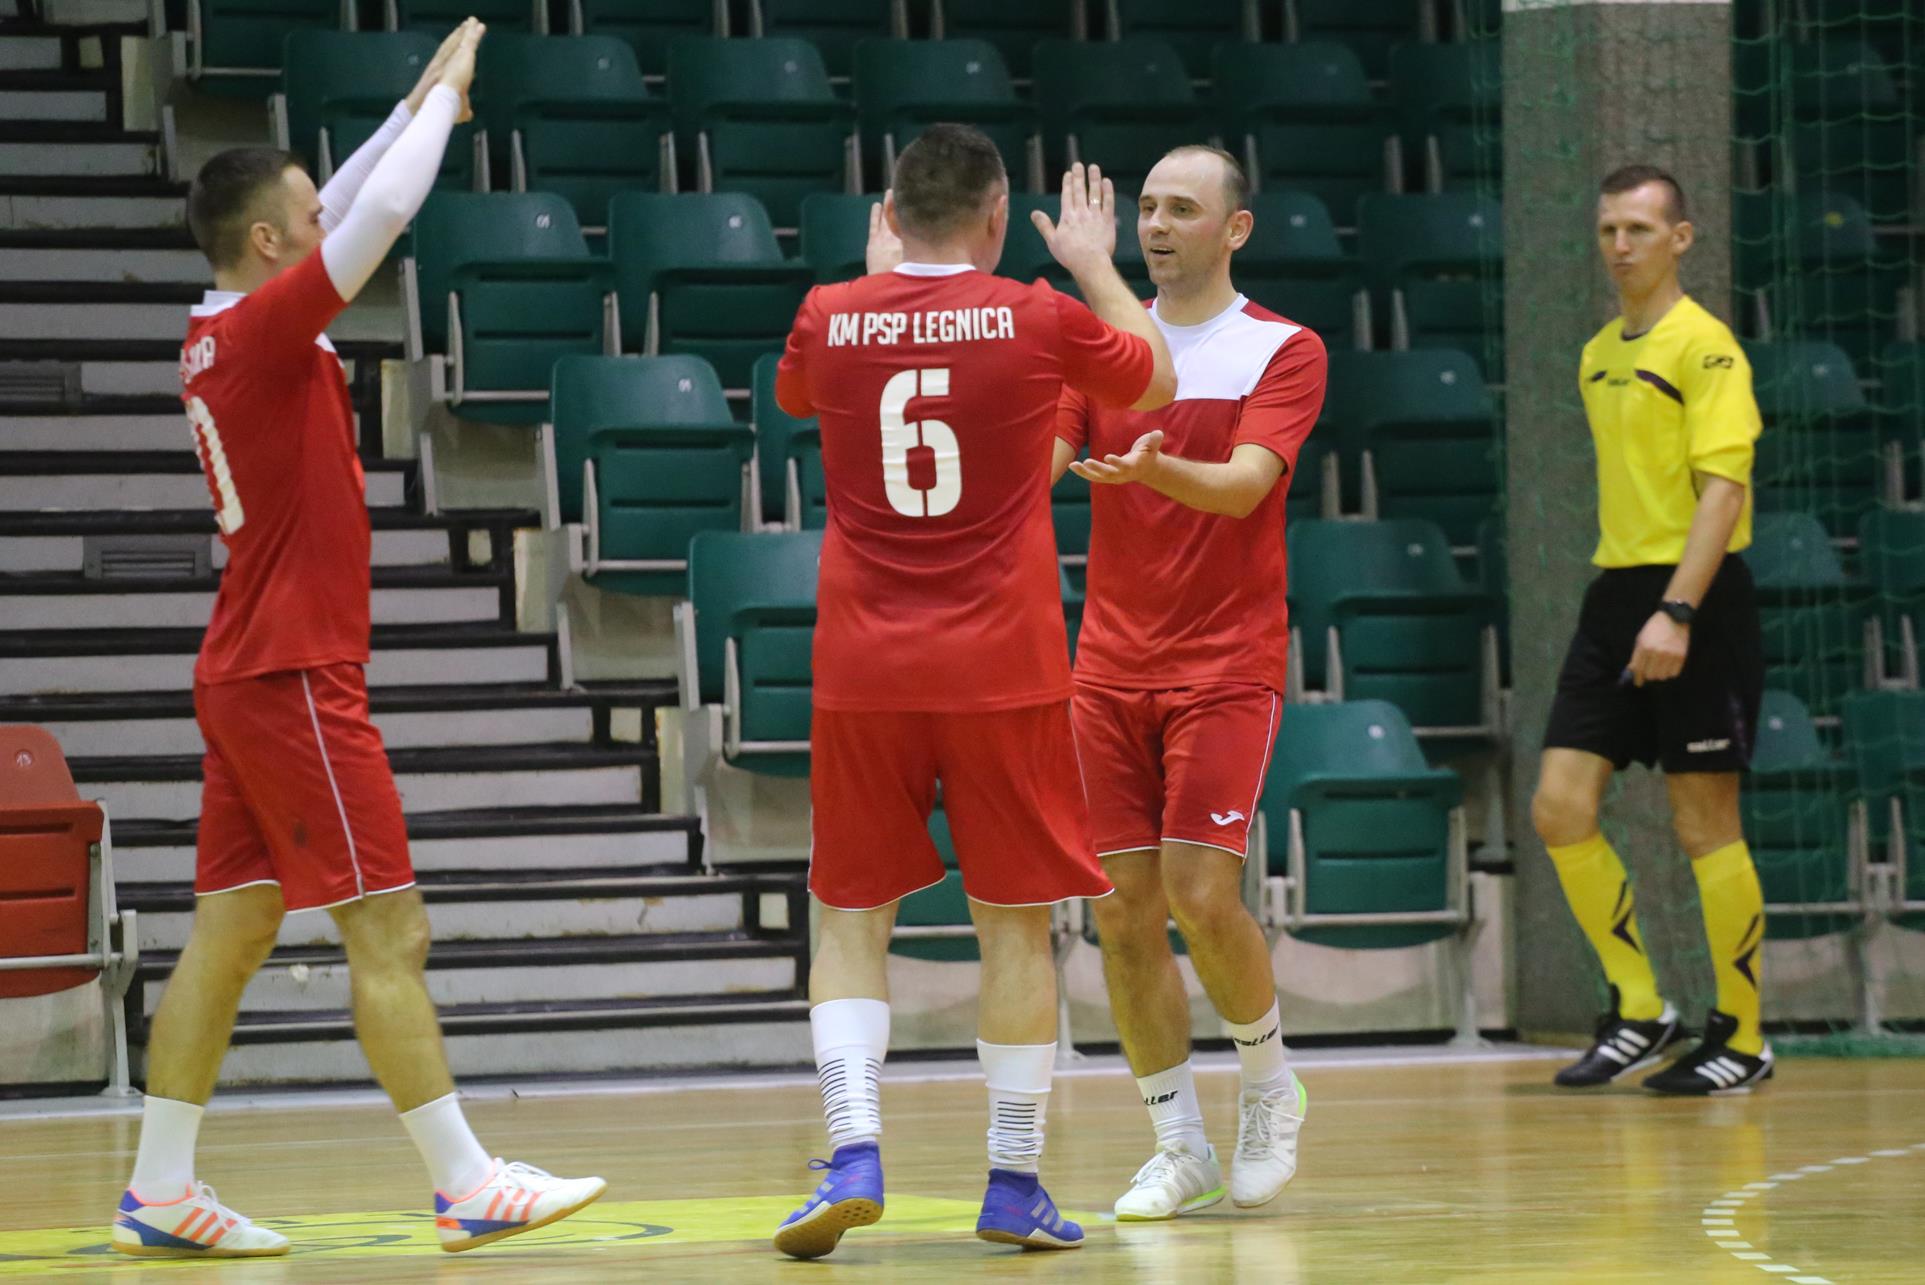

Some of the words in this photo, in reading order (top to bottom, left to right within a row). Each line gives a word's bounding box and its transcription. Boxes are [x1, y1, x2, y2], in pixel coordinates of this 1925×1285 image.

[828, 312, 860, 347] KM
[862, 312, 908, 346] PSP
[913, 307, 1015, 344] LEGNICA
[879, 368, 963, 517] 6
